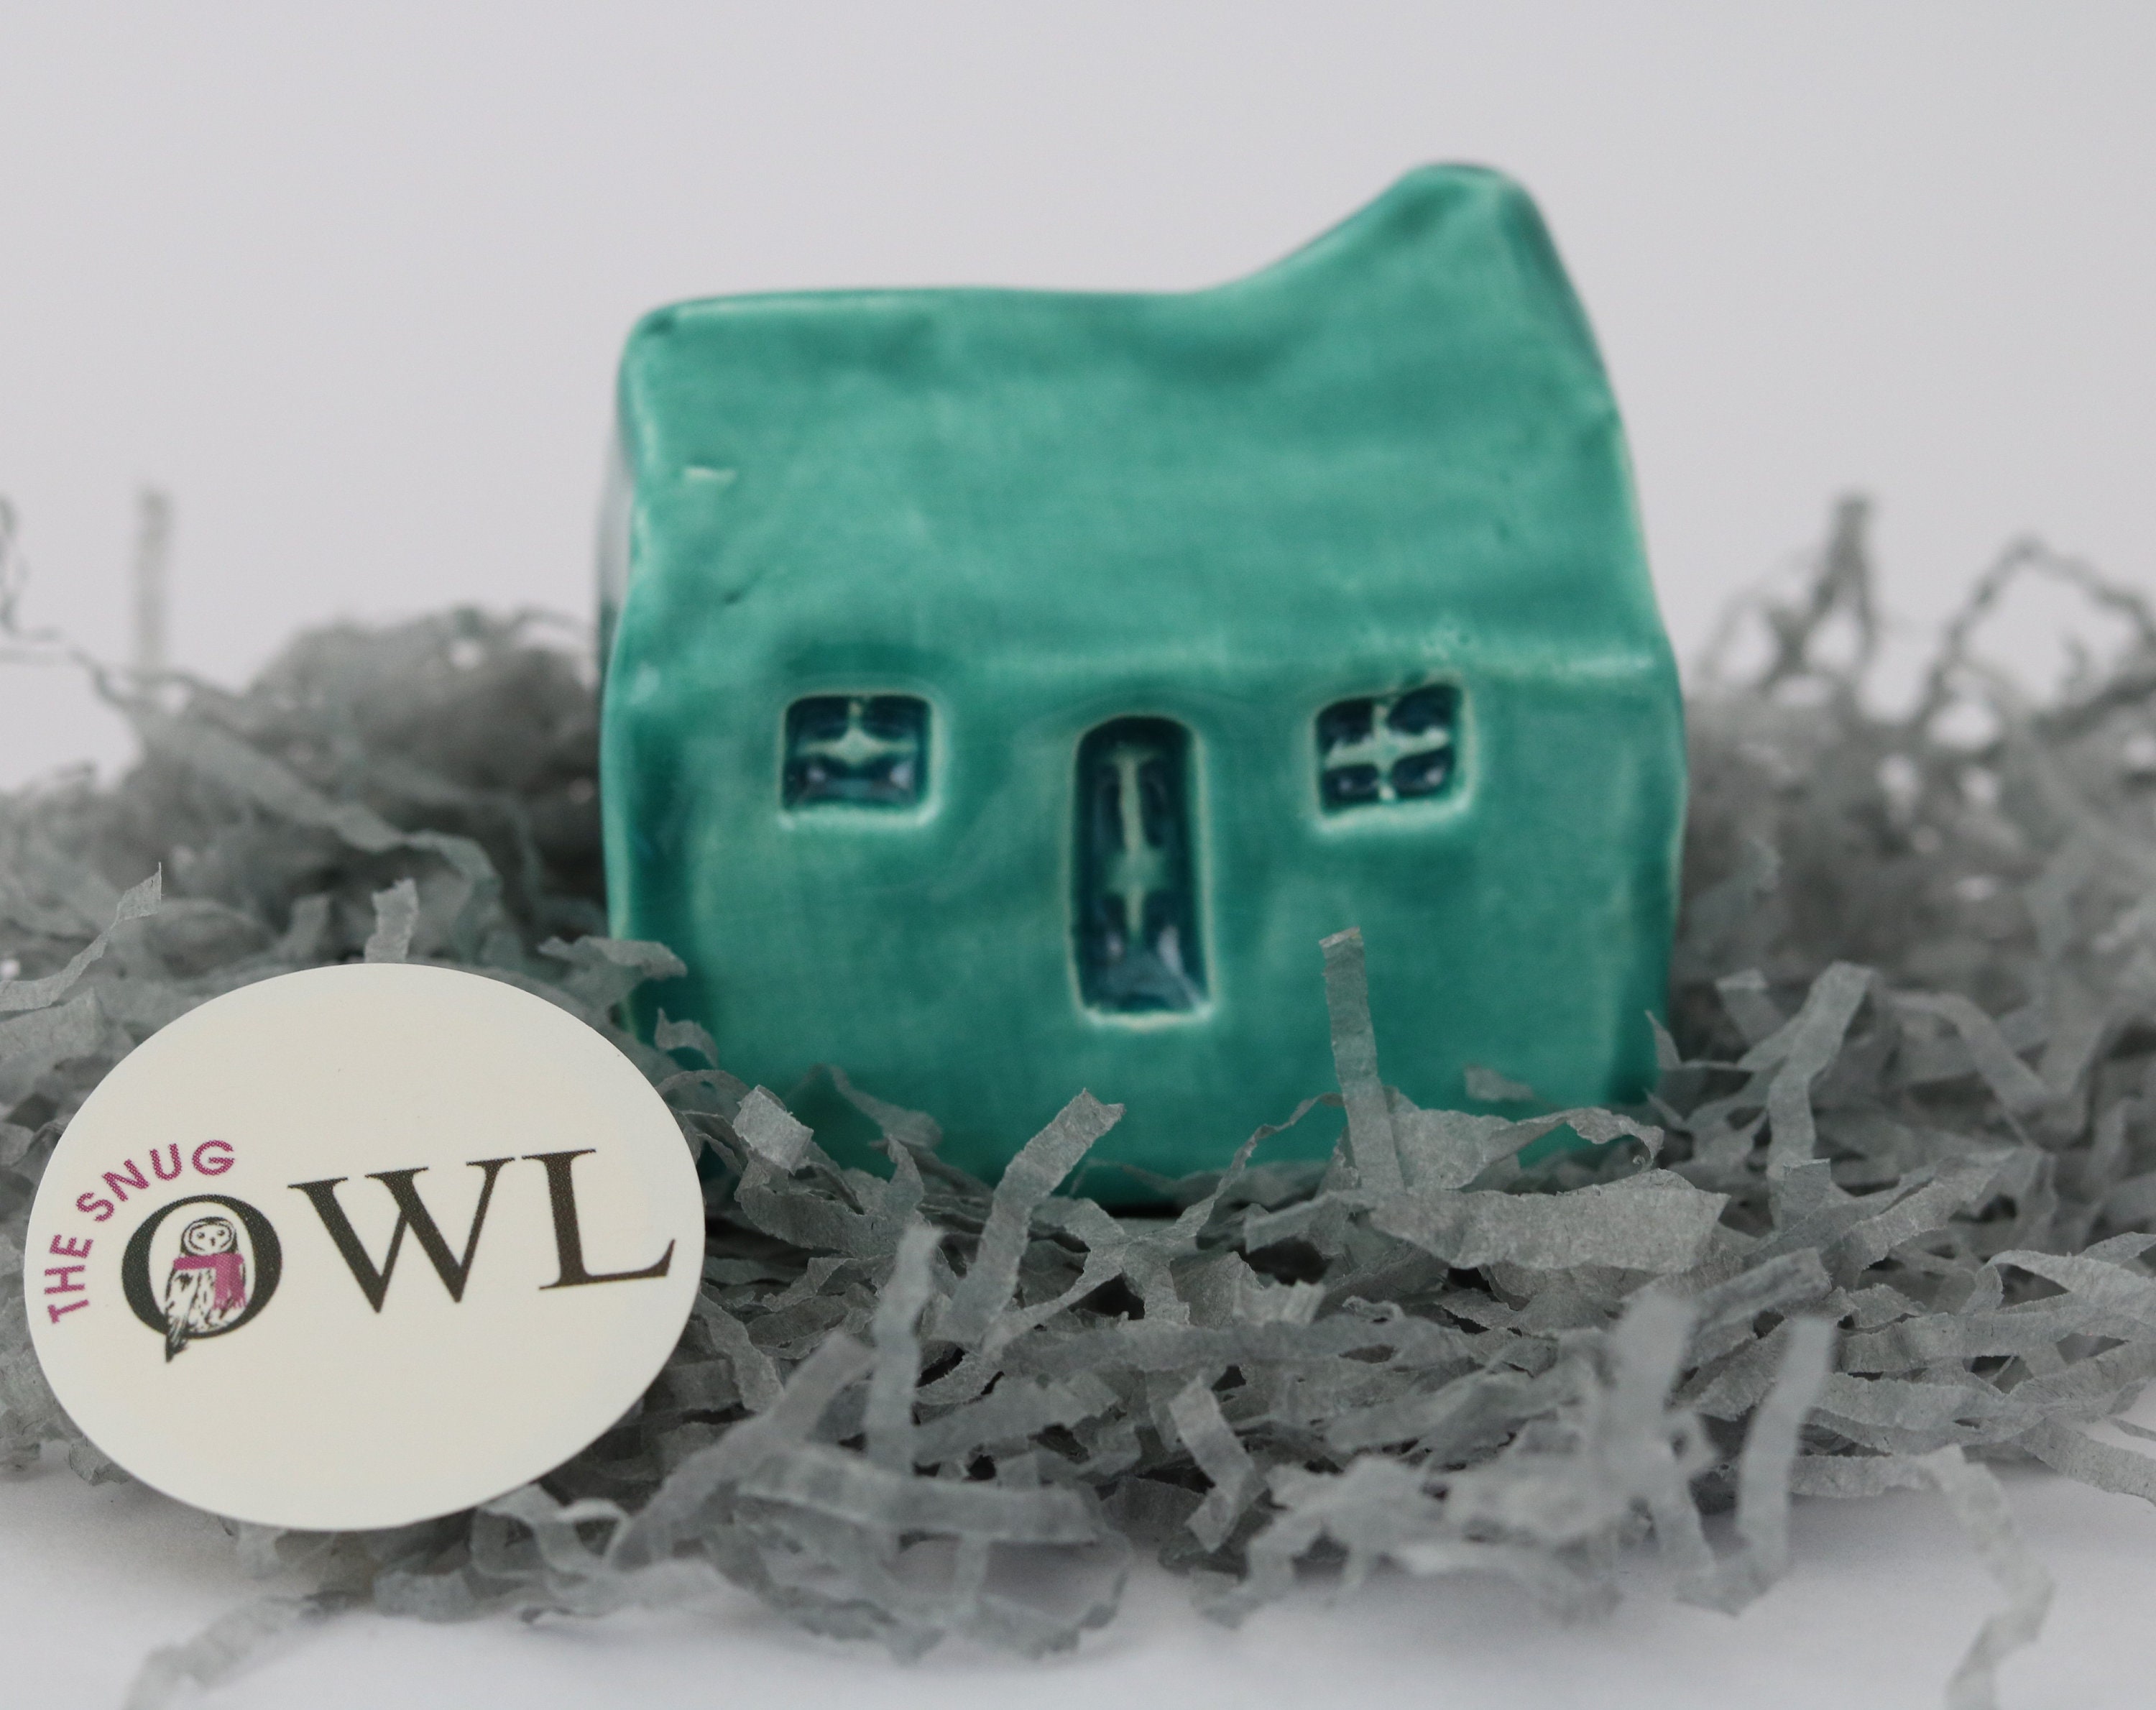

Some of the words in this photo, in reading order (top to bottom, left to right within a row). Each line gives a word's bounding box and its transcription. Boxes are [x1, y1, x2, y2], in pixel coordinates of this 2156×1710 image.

[45, 1234, 93, 1324] THE
[76, 1139, 236, 1222] SNUG
[121, 1148, 676, 1341] OWL
